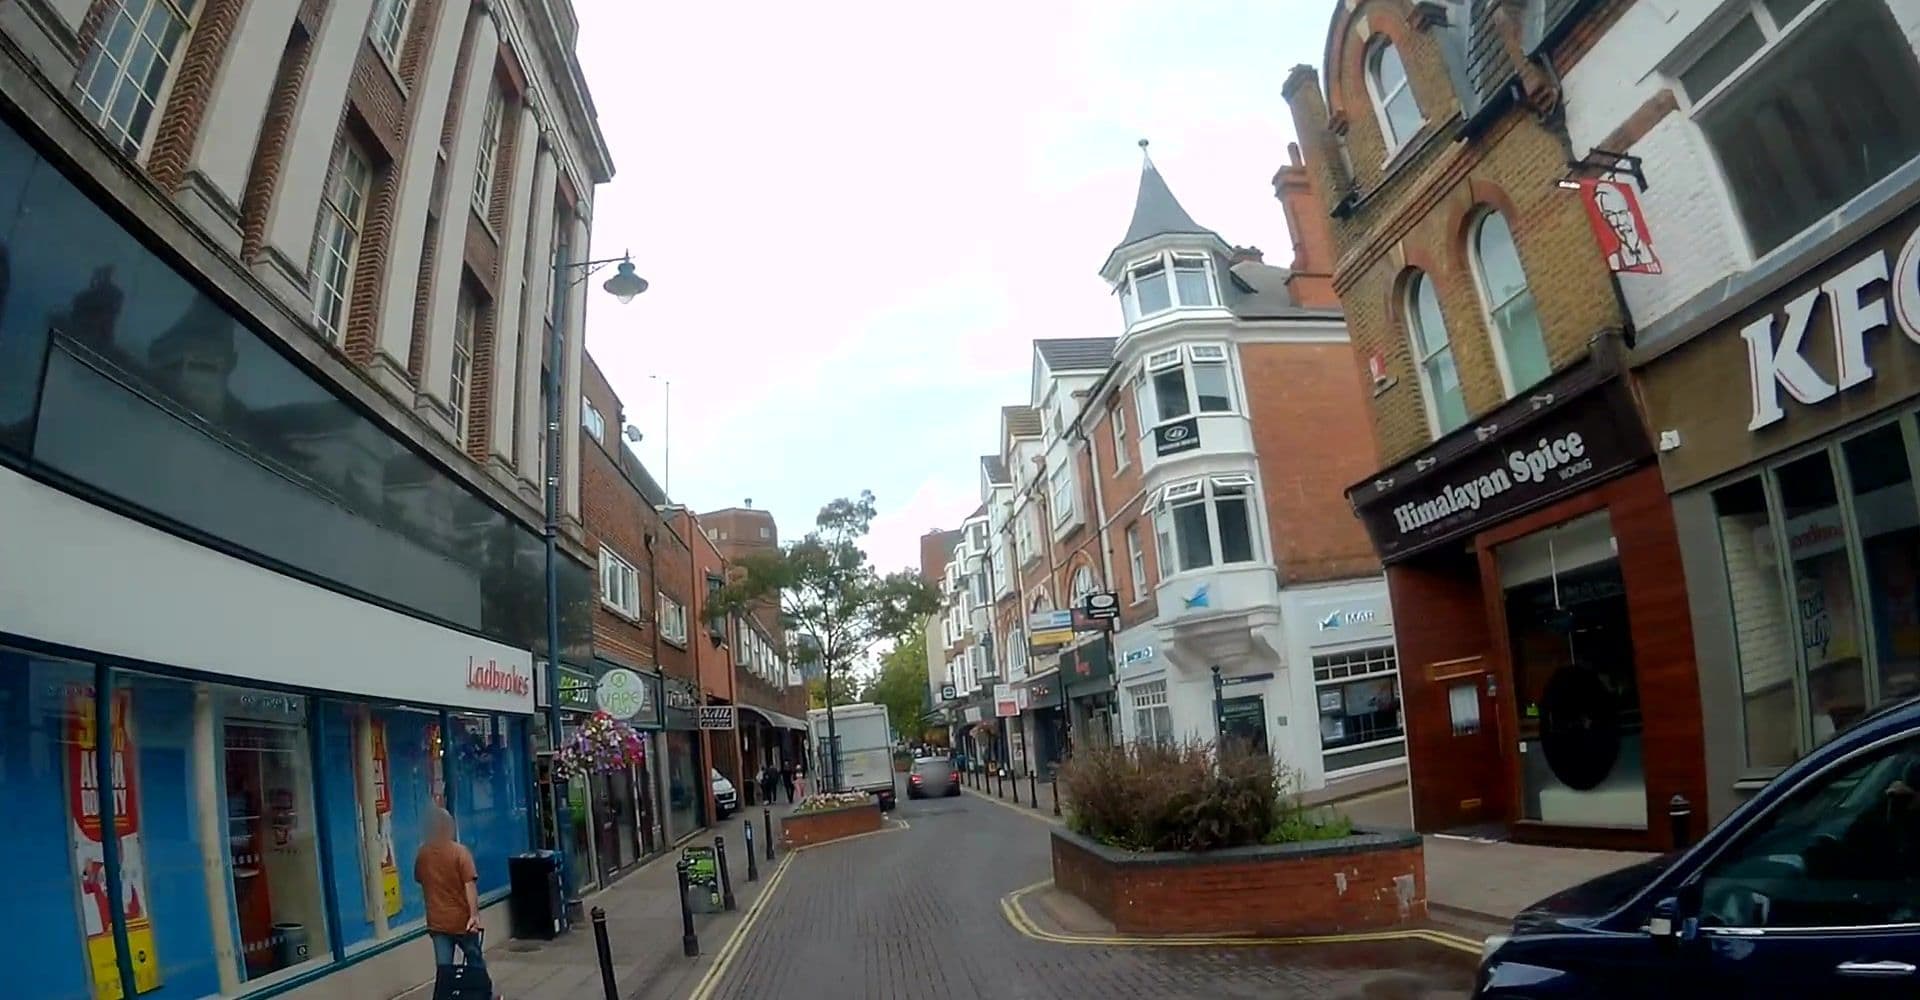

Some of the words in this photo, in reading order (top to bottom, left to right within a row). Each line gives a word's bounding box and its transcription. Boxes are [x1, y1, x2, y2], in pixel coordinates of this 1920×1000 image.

[1393, 468, 1511, 533] Himalayan
[1509, 432, 1584, 482] Spice
[466, 656, 530, 696] Ladbrokes
